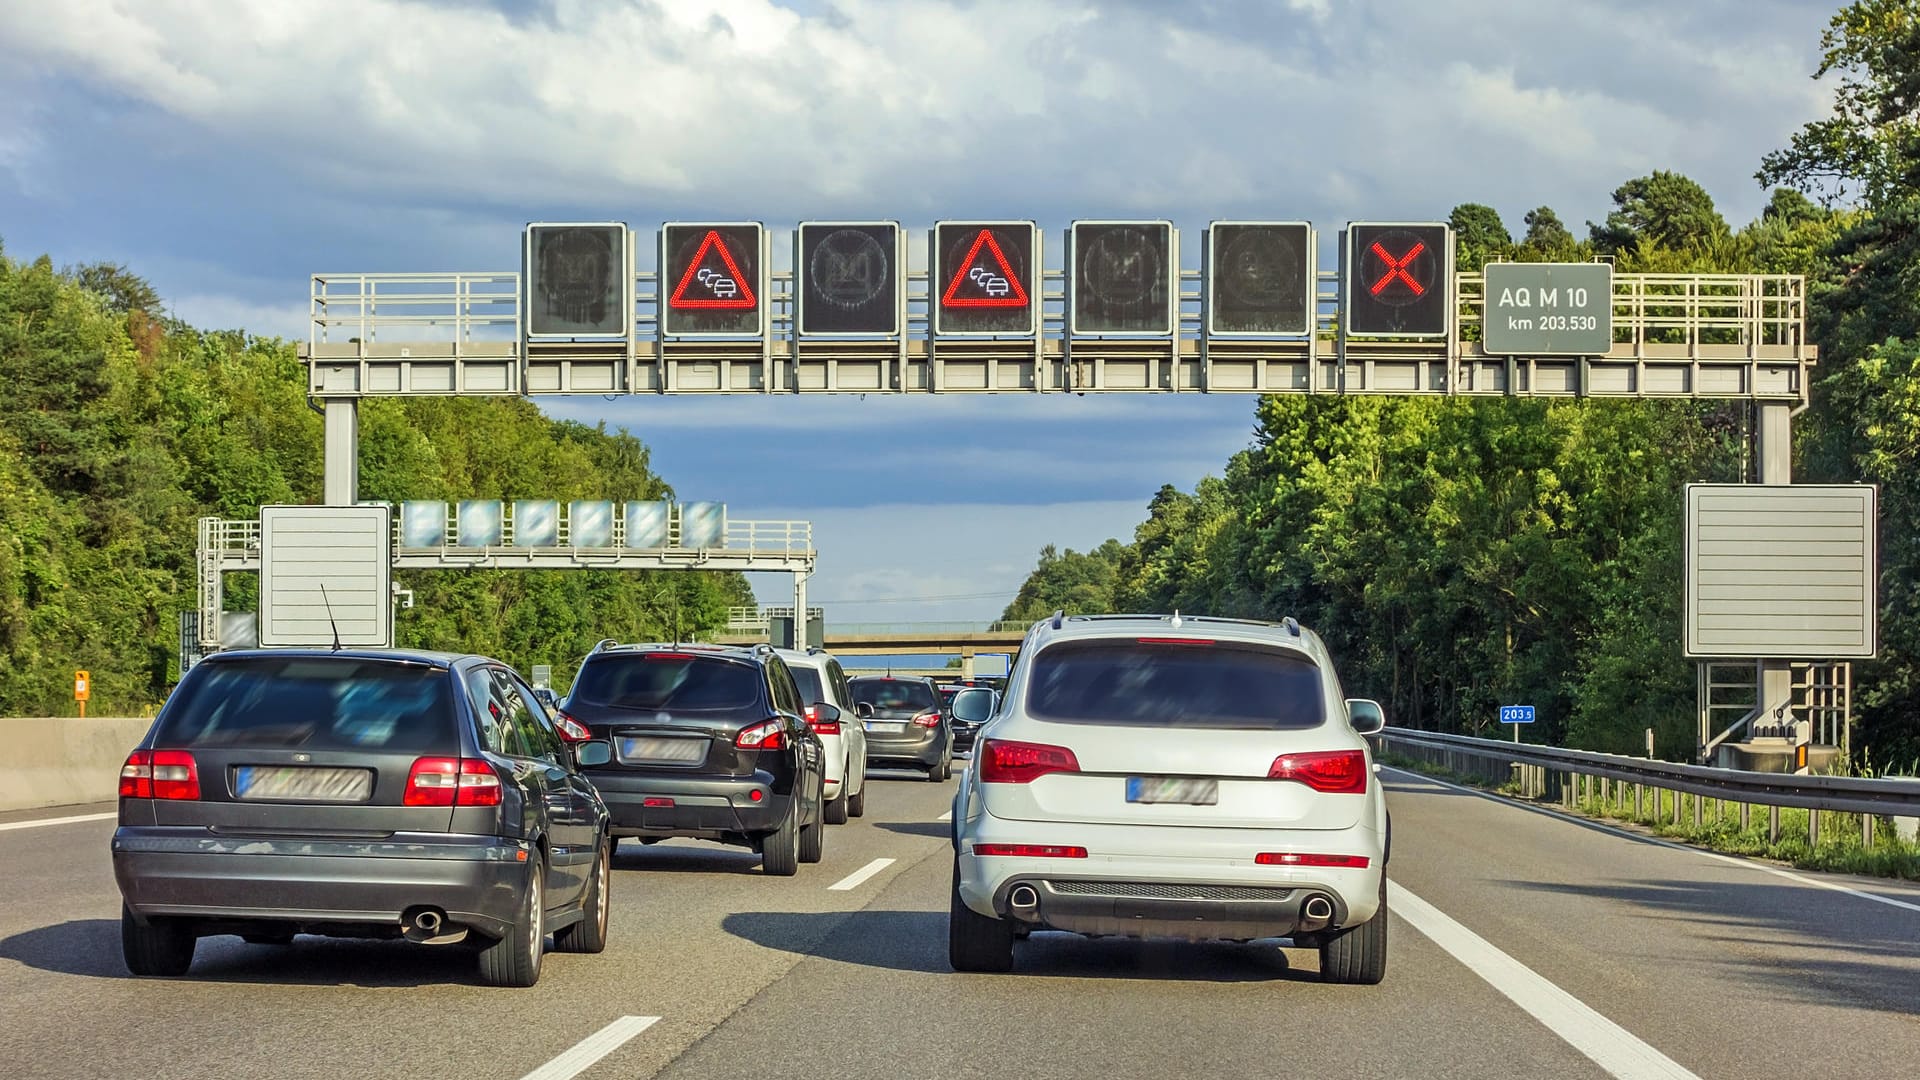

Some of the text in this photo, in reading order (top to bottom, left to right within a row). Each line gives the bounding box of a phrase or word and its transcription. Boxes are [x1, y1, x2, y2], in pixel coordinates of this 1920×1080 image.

[1498, 287, 1588, 308] AQ M 10
[1508, 316, 1533, 330] km
